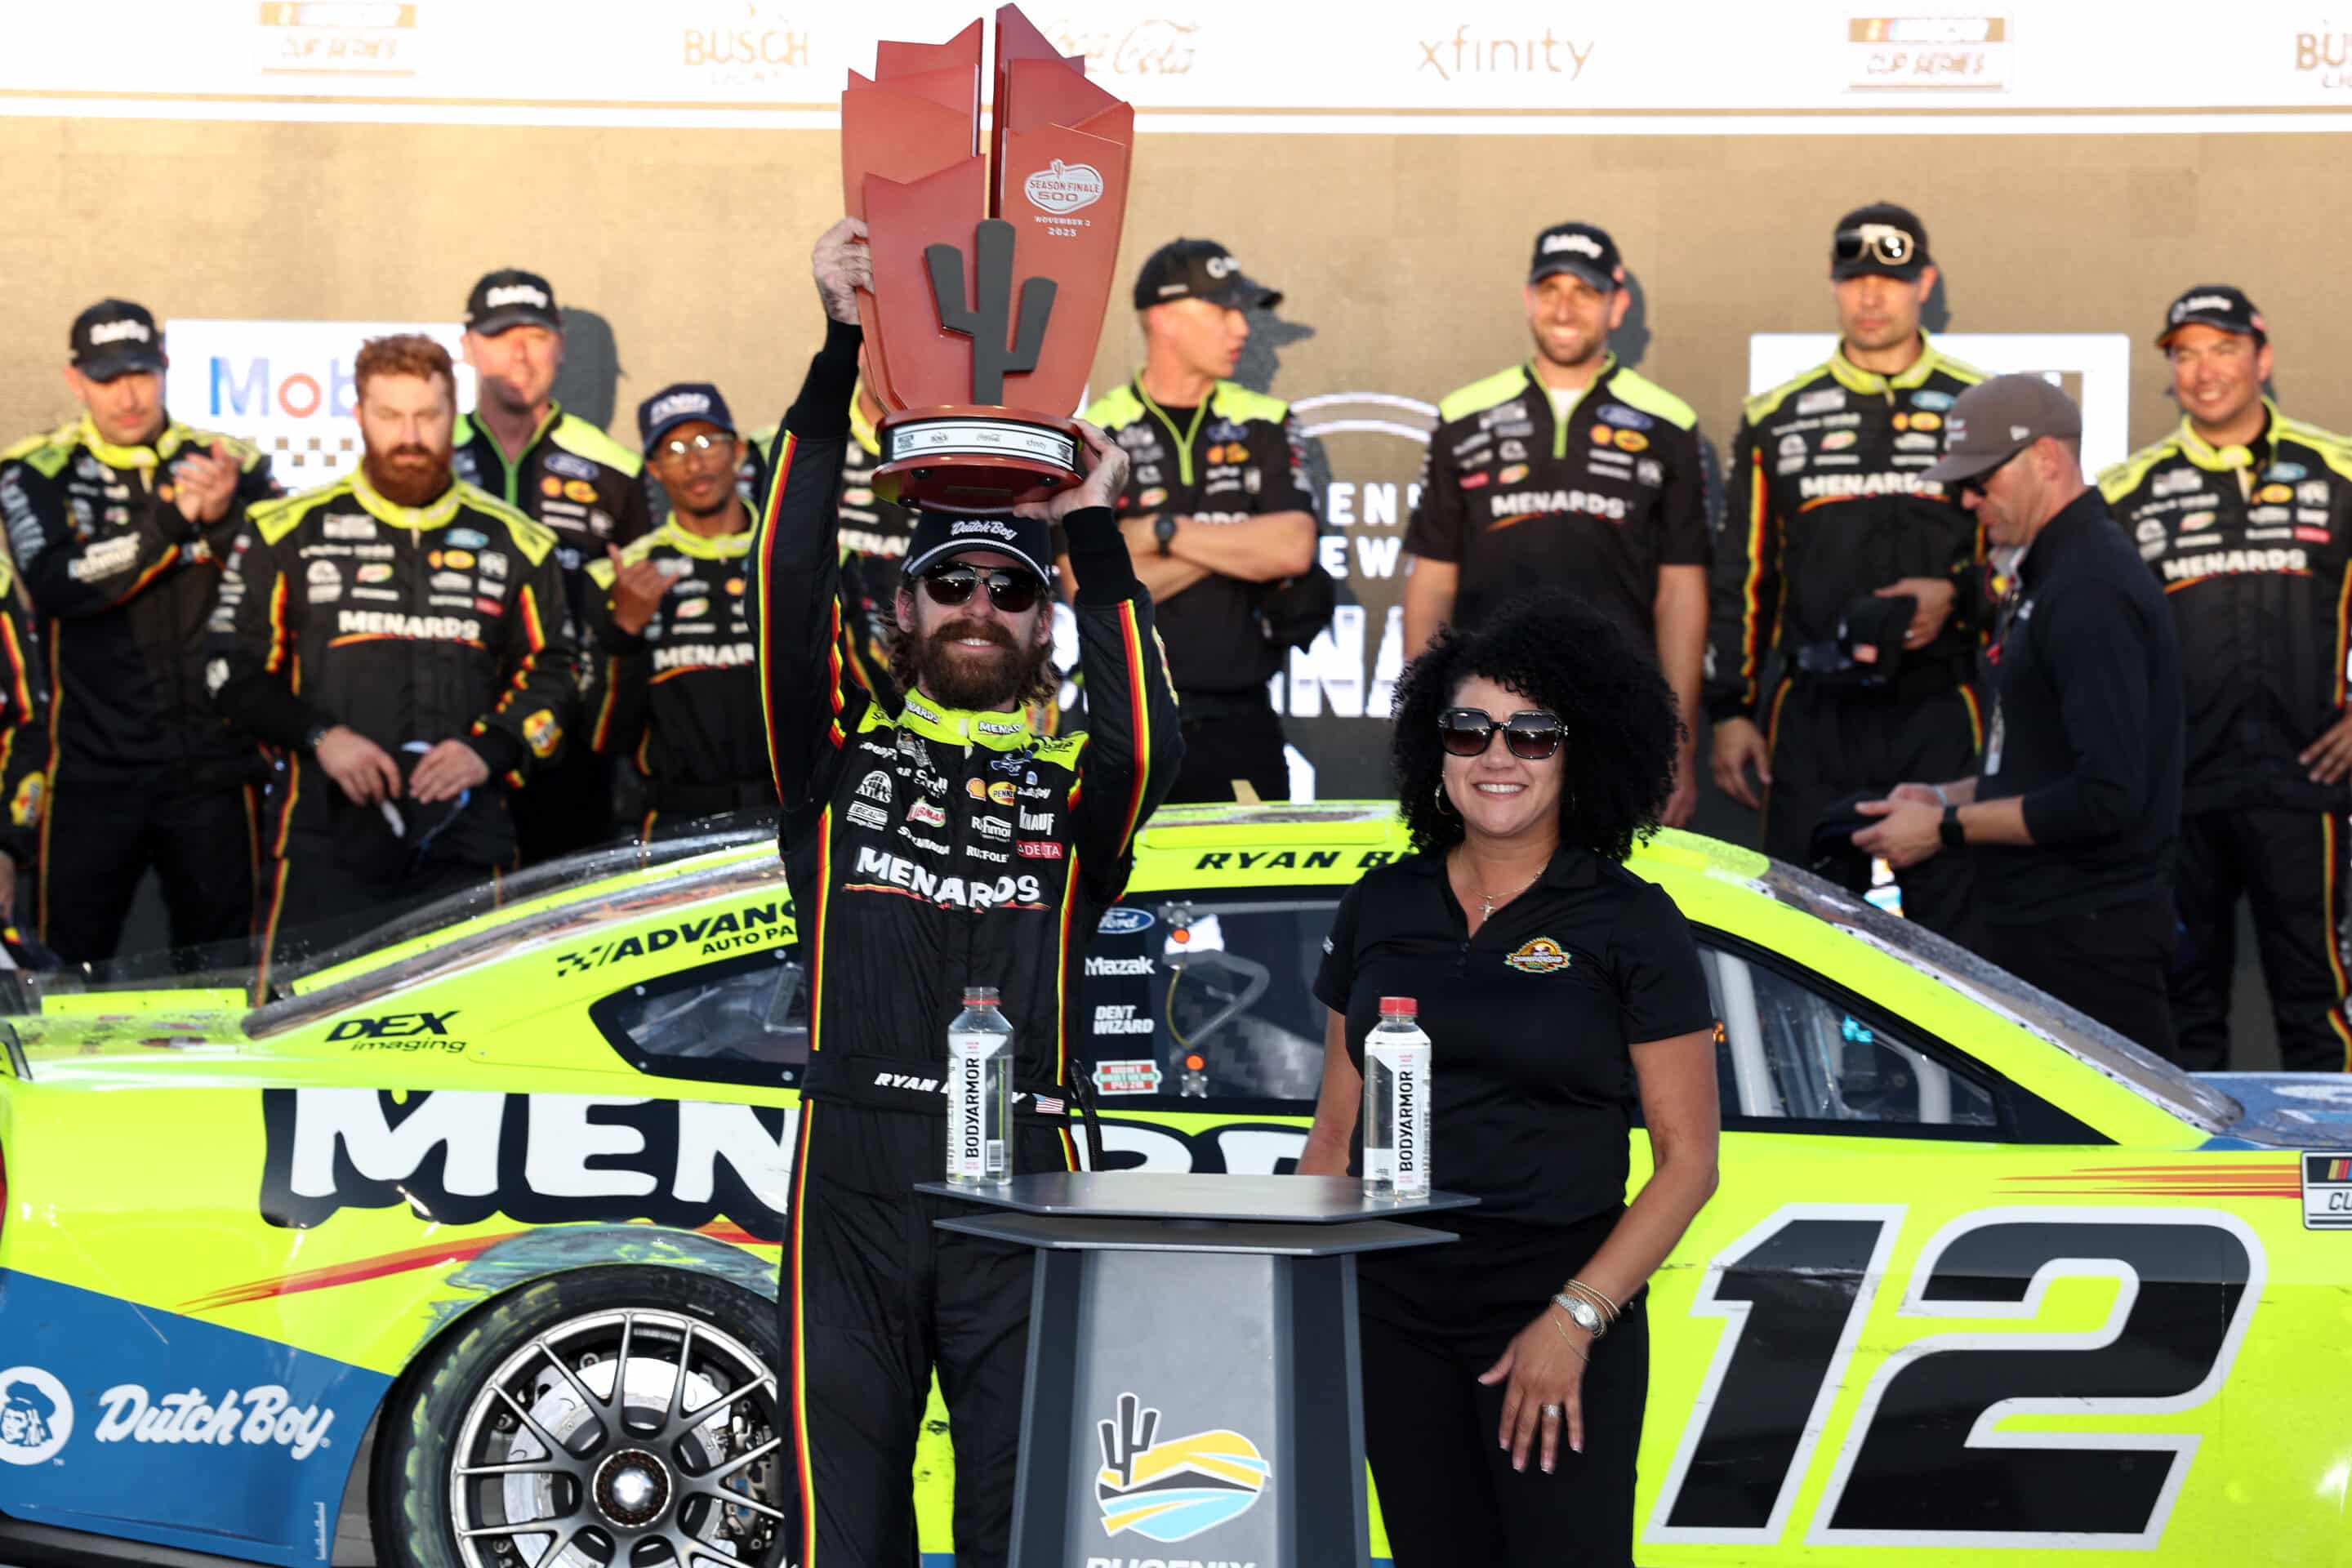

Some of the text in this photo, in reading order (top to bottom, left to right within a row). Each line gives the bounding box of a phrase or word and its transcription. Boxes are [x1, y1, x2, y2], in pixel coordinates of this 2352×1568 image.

[684, 29, 808, 67] BUSCH
[1417, 24, 1595, 81] xfinity
[1029, 179, 1100, 194] SEASON FINALE
[1038, 191, 1078, 202] 500
[1034, 216, 1091, 227] NOVEMBER 2
[1047, 227, 1077, 237] 2025
[210, 356, 359, 418] Mob
[951, 520, 1018, 540] Dutch Boy
[338, 610, 480, 639] MENARDS
[654, 643, 755, 670] MENAR
[856, 784, 893, 804] ATLAS
[1025, 844, 1061, 858] DELTA
[1194, 851, 1342, 870] RYAN
[856, 846, 1041, 909] MENARDS
[610, 899, 795, 963] ADVANC
[702, 933, 760, 956] AUTO
[1085, 956, 1156, 977] Mazak
[1095, 1005, 1136, 1020] DENT
[324, 1010, 461, 1042] DEX
[1093, 1018, 1155, 1035] WIZARD
[351, 1036, 467, 1054] imaging
[875, 1072, 939, 1092] RYAN
[965, 1058, 980, 1158] BODYARMOR
[1399, 1071, 1414, 1172] BODYARMOR
[2328, 1192, 2352, 1210] CU
[1641, 1203, 2268, 1551] 12
[95, 1384, 335, 1461] Dutch Boy
